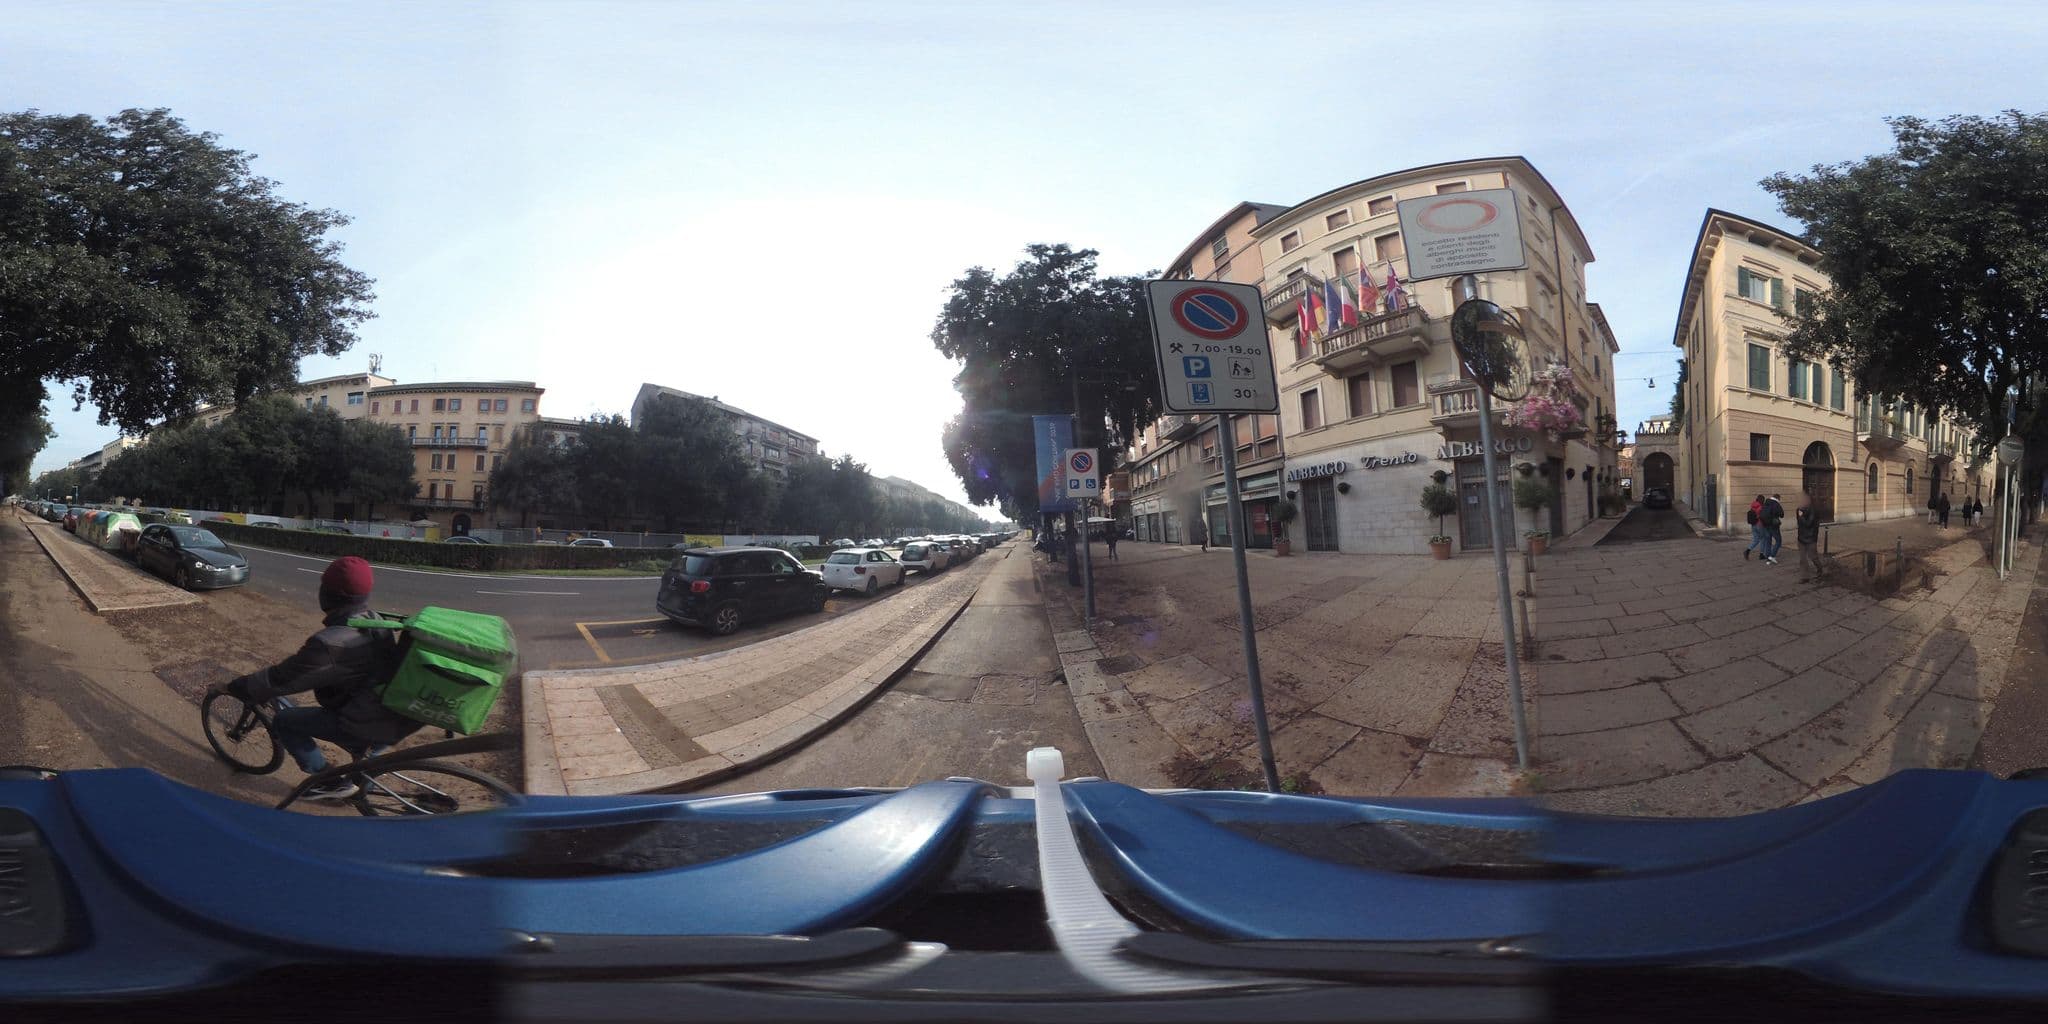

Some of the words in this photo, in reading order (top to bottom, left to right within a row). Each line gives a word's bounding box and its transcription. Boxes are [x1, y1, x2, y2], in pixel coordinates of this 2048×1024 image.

[1431, 258, 1496, 270] contrassegno
[1286, 460, 1346, 482] ALBERGO
[1360, 450, 1418, 471] Trento
[418, 685, 466, 711] Uber
[408, 699, 458, 725] Eats
